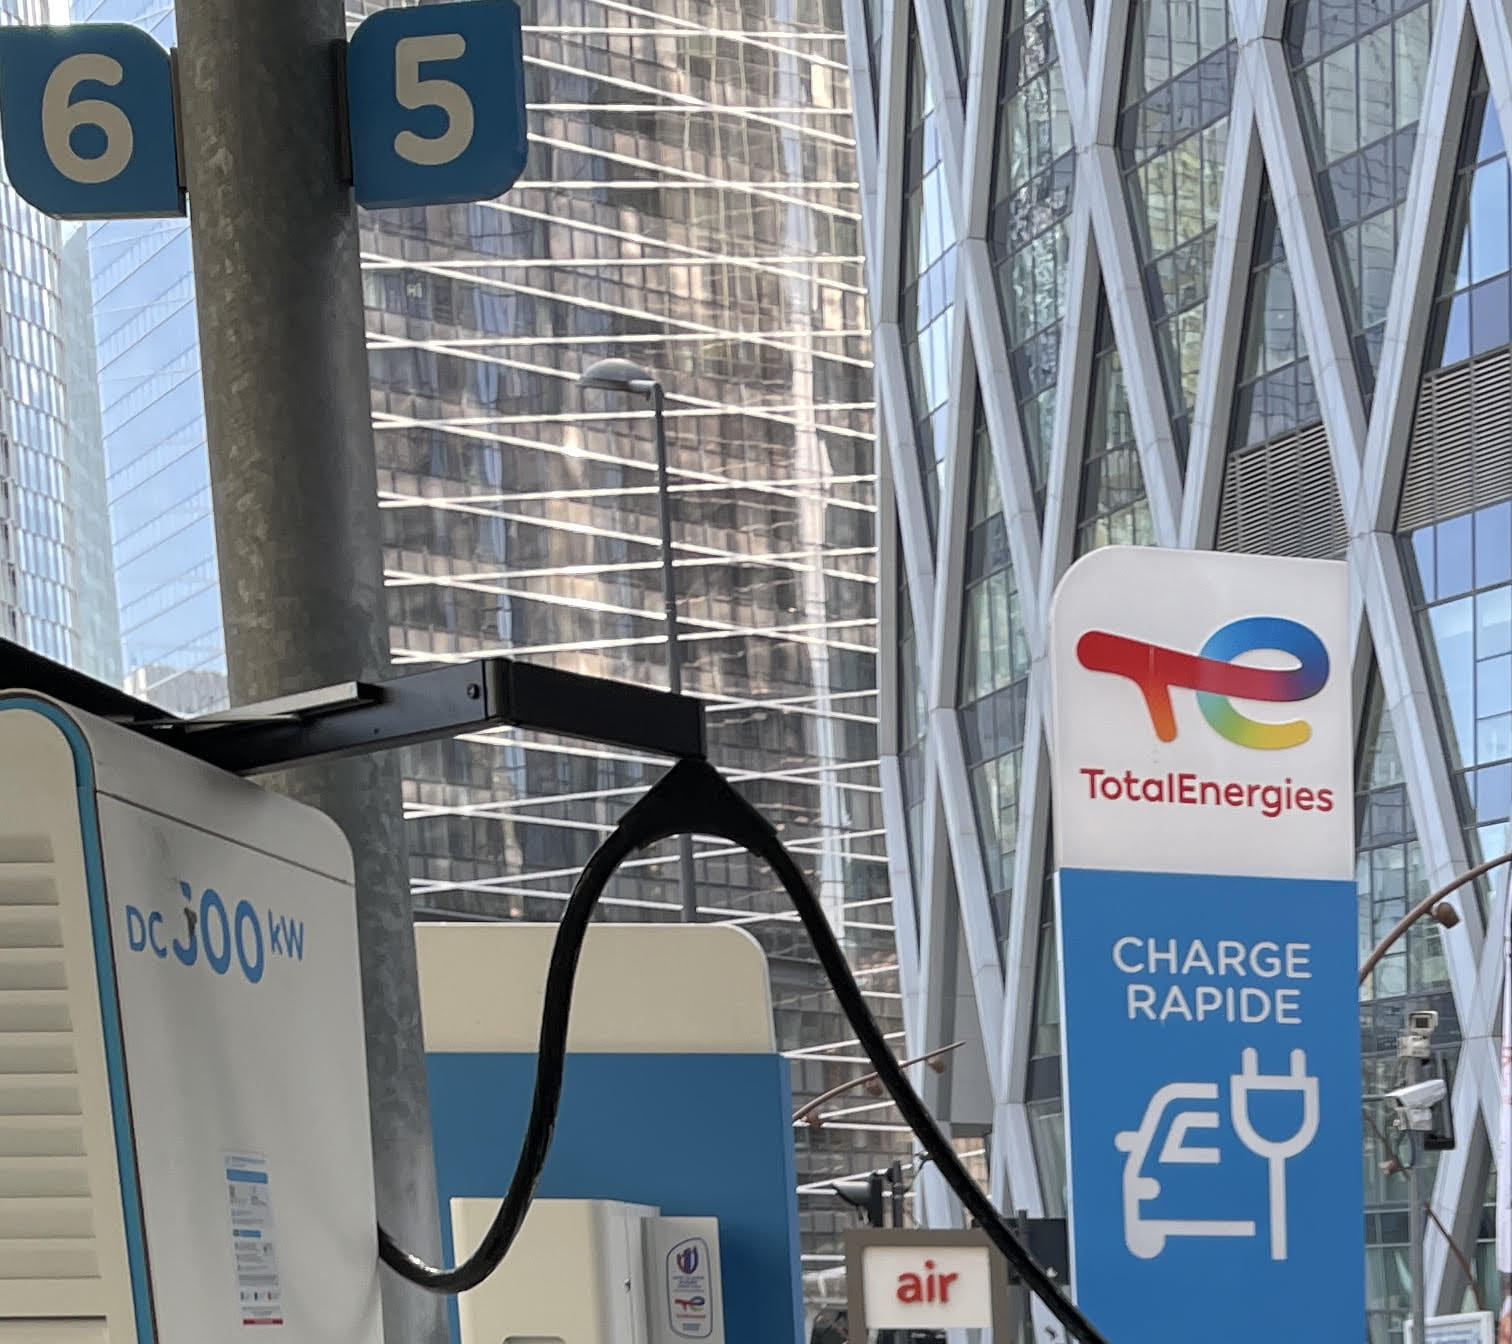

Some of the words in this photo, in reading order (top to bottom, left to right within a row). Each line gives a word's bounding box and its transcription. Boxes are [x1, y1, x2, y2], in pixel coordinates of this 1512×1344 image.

[41, 53, 134, 185] 6
[394, 33, 475, 166] 5
[1080, 767, 1334, 818] TotalEnergies
[126, 904, 168, 959] DC
[268, 908, 304, 961] kW
[1112, 936, 1313, 979] CHARGE
[1127, 983, 1302, 1025] RAPIDE
[896, 1259, 960, 1304] air
